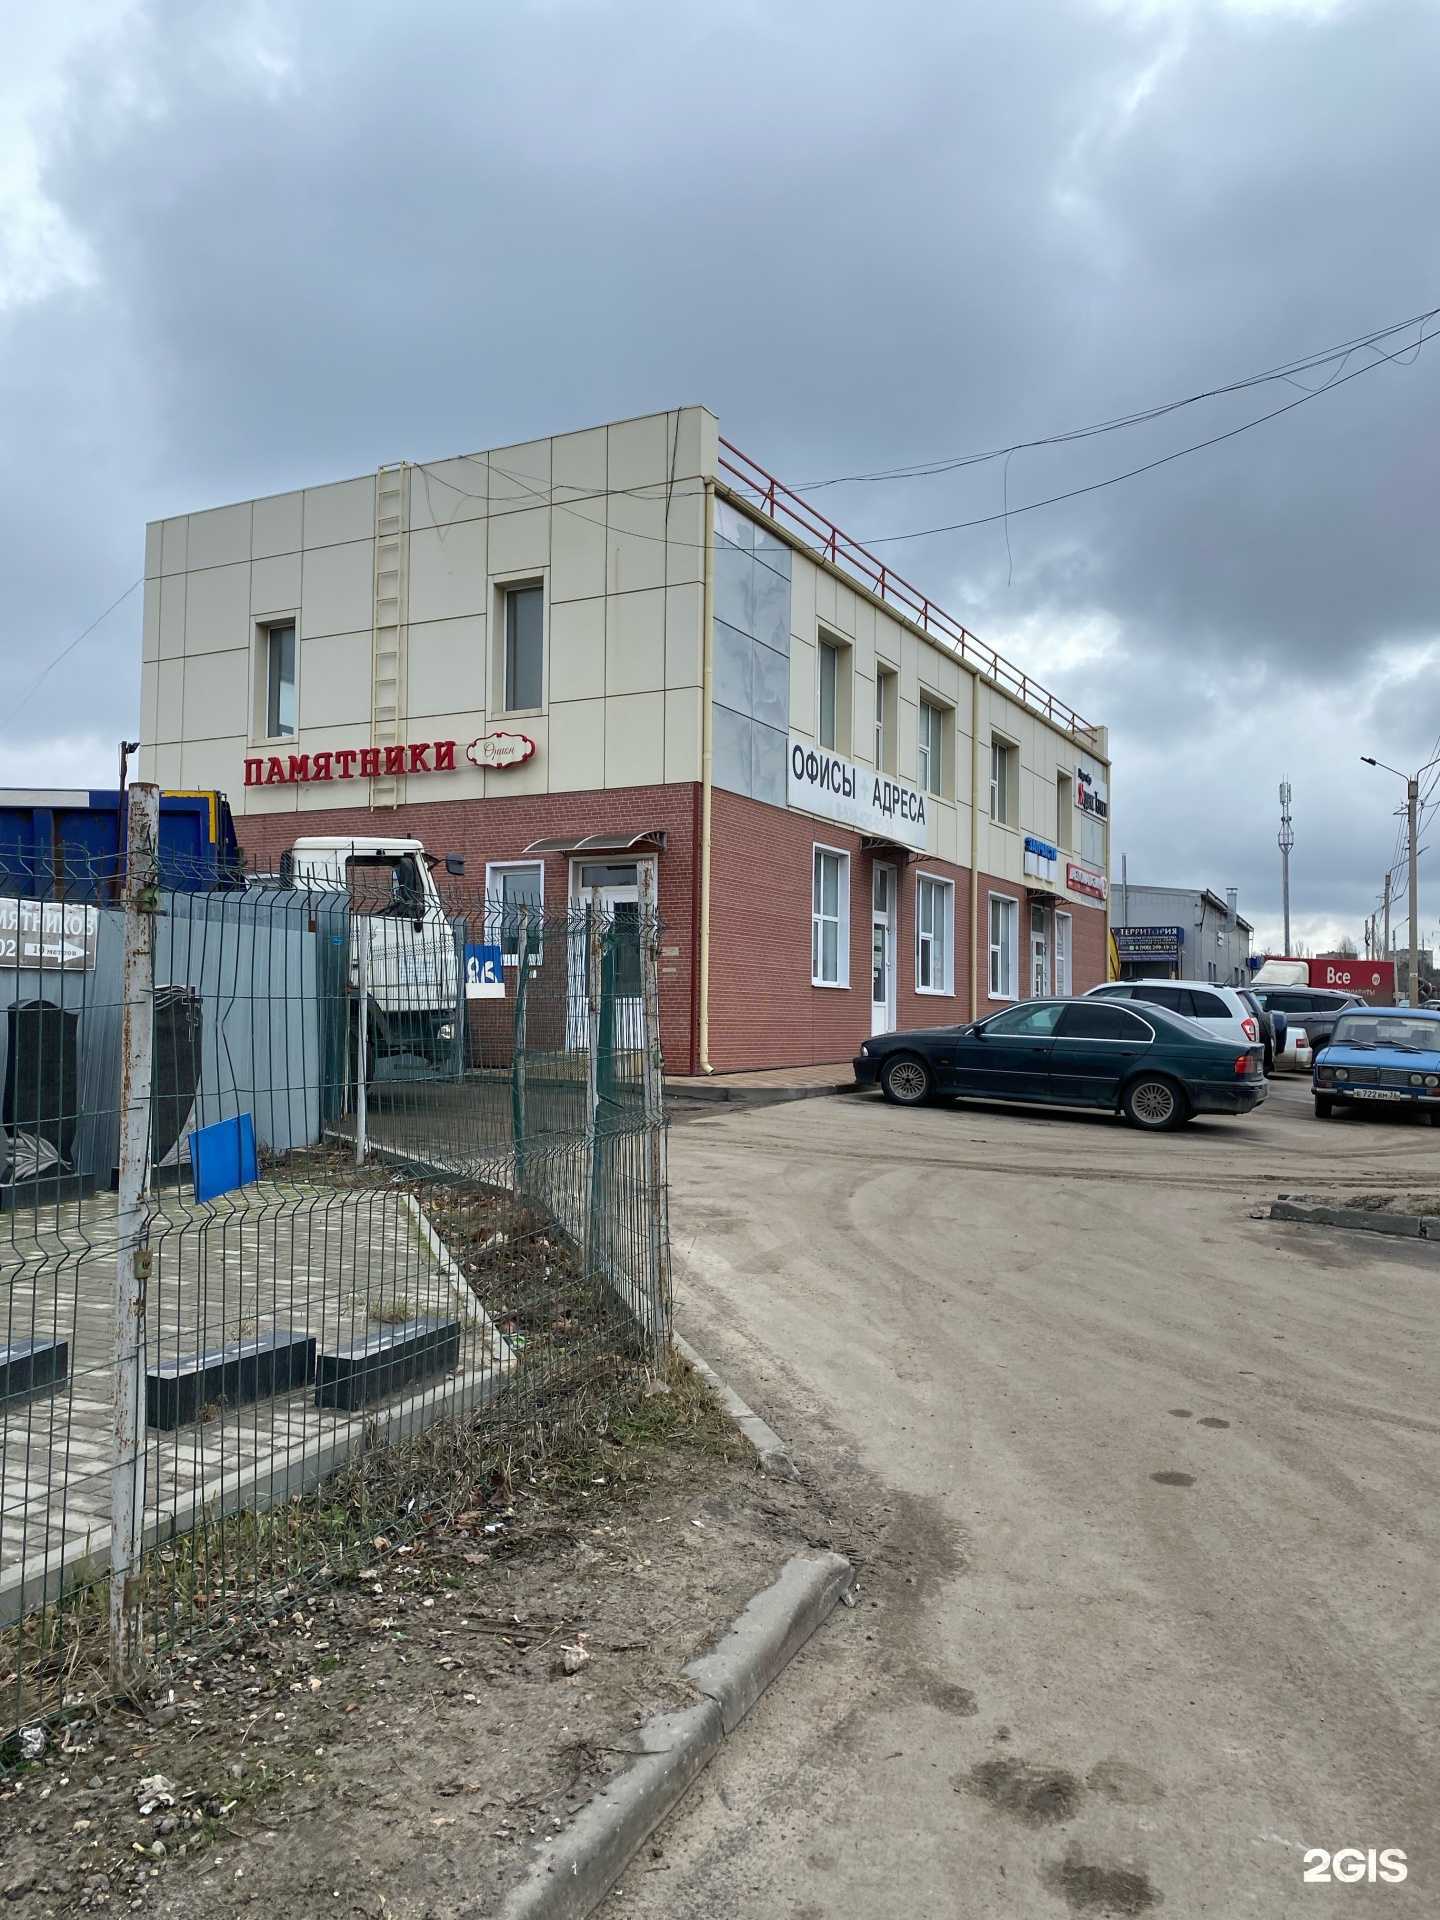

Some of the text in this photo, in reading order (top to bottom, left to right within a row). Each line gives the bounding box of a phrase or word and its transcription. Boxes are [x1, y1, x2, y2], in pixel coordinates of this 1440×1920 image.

[244, 740, 456, 786] ПАМЯТНИКИ
[792, 744, 856, 800] ОФИСЫ
[872, 777, 926, 825] АДРЕСА
[1120, 928, 1177, 936] ТЕРРИТОРИЯ
[1327, 966, 1351, 985] Все
